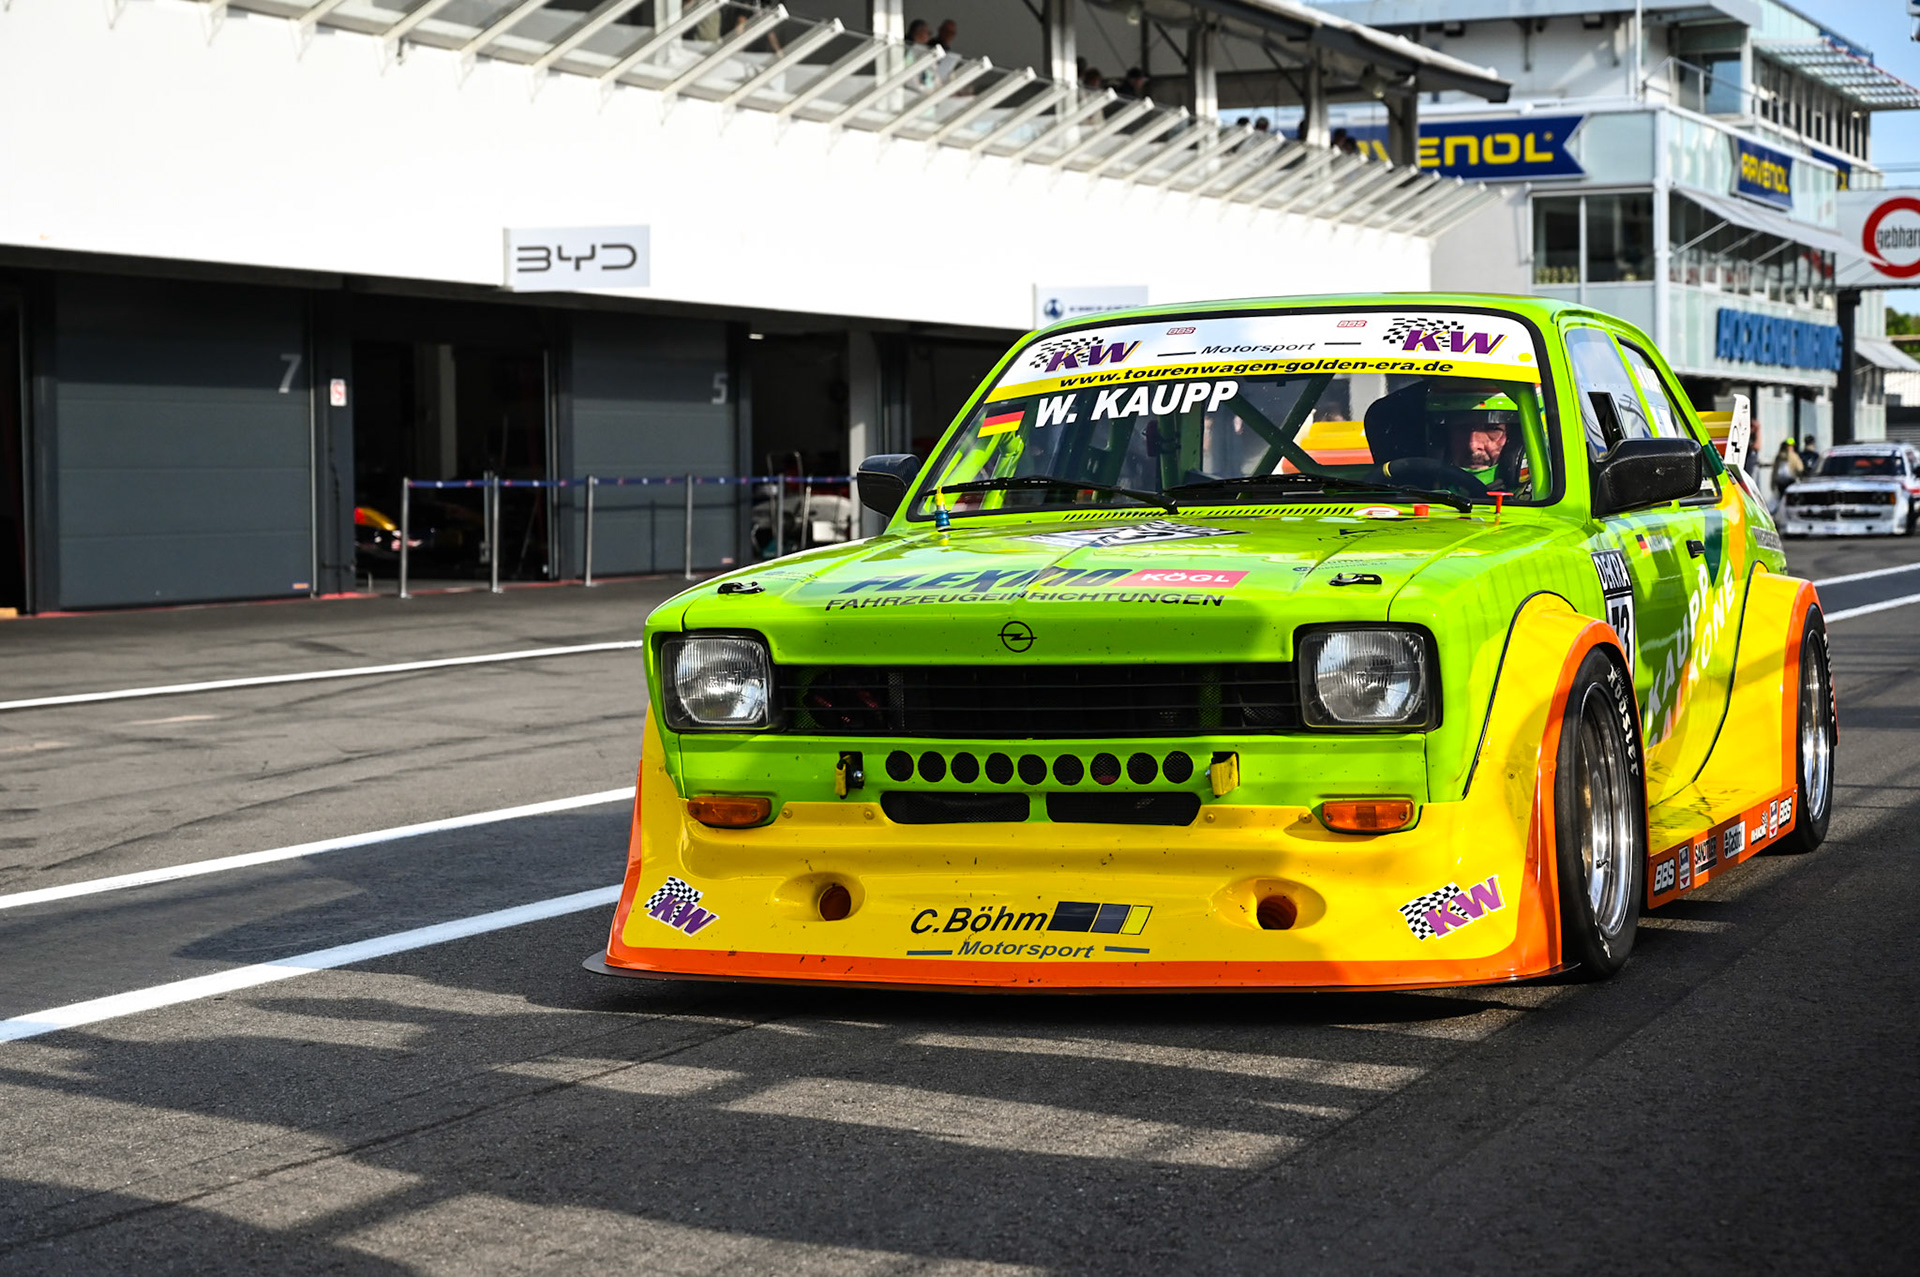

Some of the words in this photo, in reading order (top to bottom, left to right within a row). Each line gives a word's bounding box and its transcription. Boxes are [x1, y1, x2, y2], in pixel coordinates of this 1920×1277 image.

[1877, 225, 1920, 249] gebhar
[517, 243, 637, 273] BYD
[1045, 340, 1142, 373] KW
[1201, 342, 1316, 356] Motorsport
[1402, 329, 1507, 355] KW
[278, 354, 302, 394] 7
[1060, 358, 1453, 387] www.tourenwagen-golden-era.de
[711, 372, 729, 405] 5
[1035, 393, 1078, 428] W.
[1090, 380, 1239, 421] KAUPP
[1141, 571, 1230, 583] KÖGL
[1593, 552, 1631, 591] DEKRA
[825, 590, 1226, 612] FAHRZEUGEINRICHTUNGEN
[1647, 563, 1709, 733] KAUPP
[1654, 858, 1676, 895] BBS
[648, 893, 719, 936] KW
[910, 906, 1048, 934] C.Böhm
[1423, 875, 1505, 938] KW
[957, 941, 1095, 959] Motorsport
